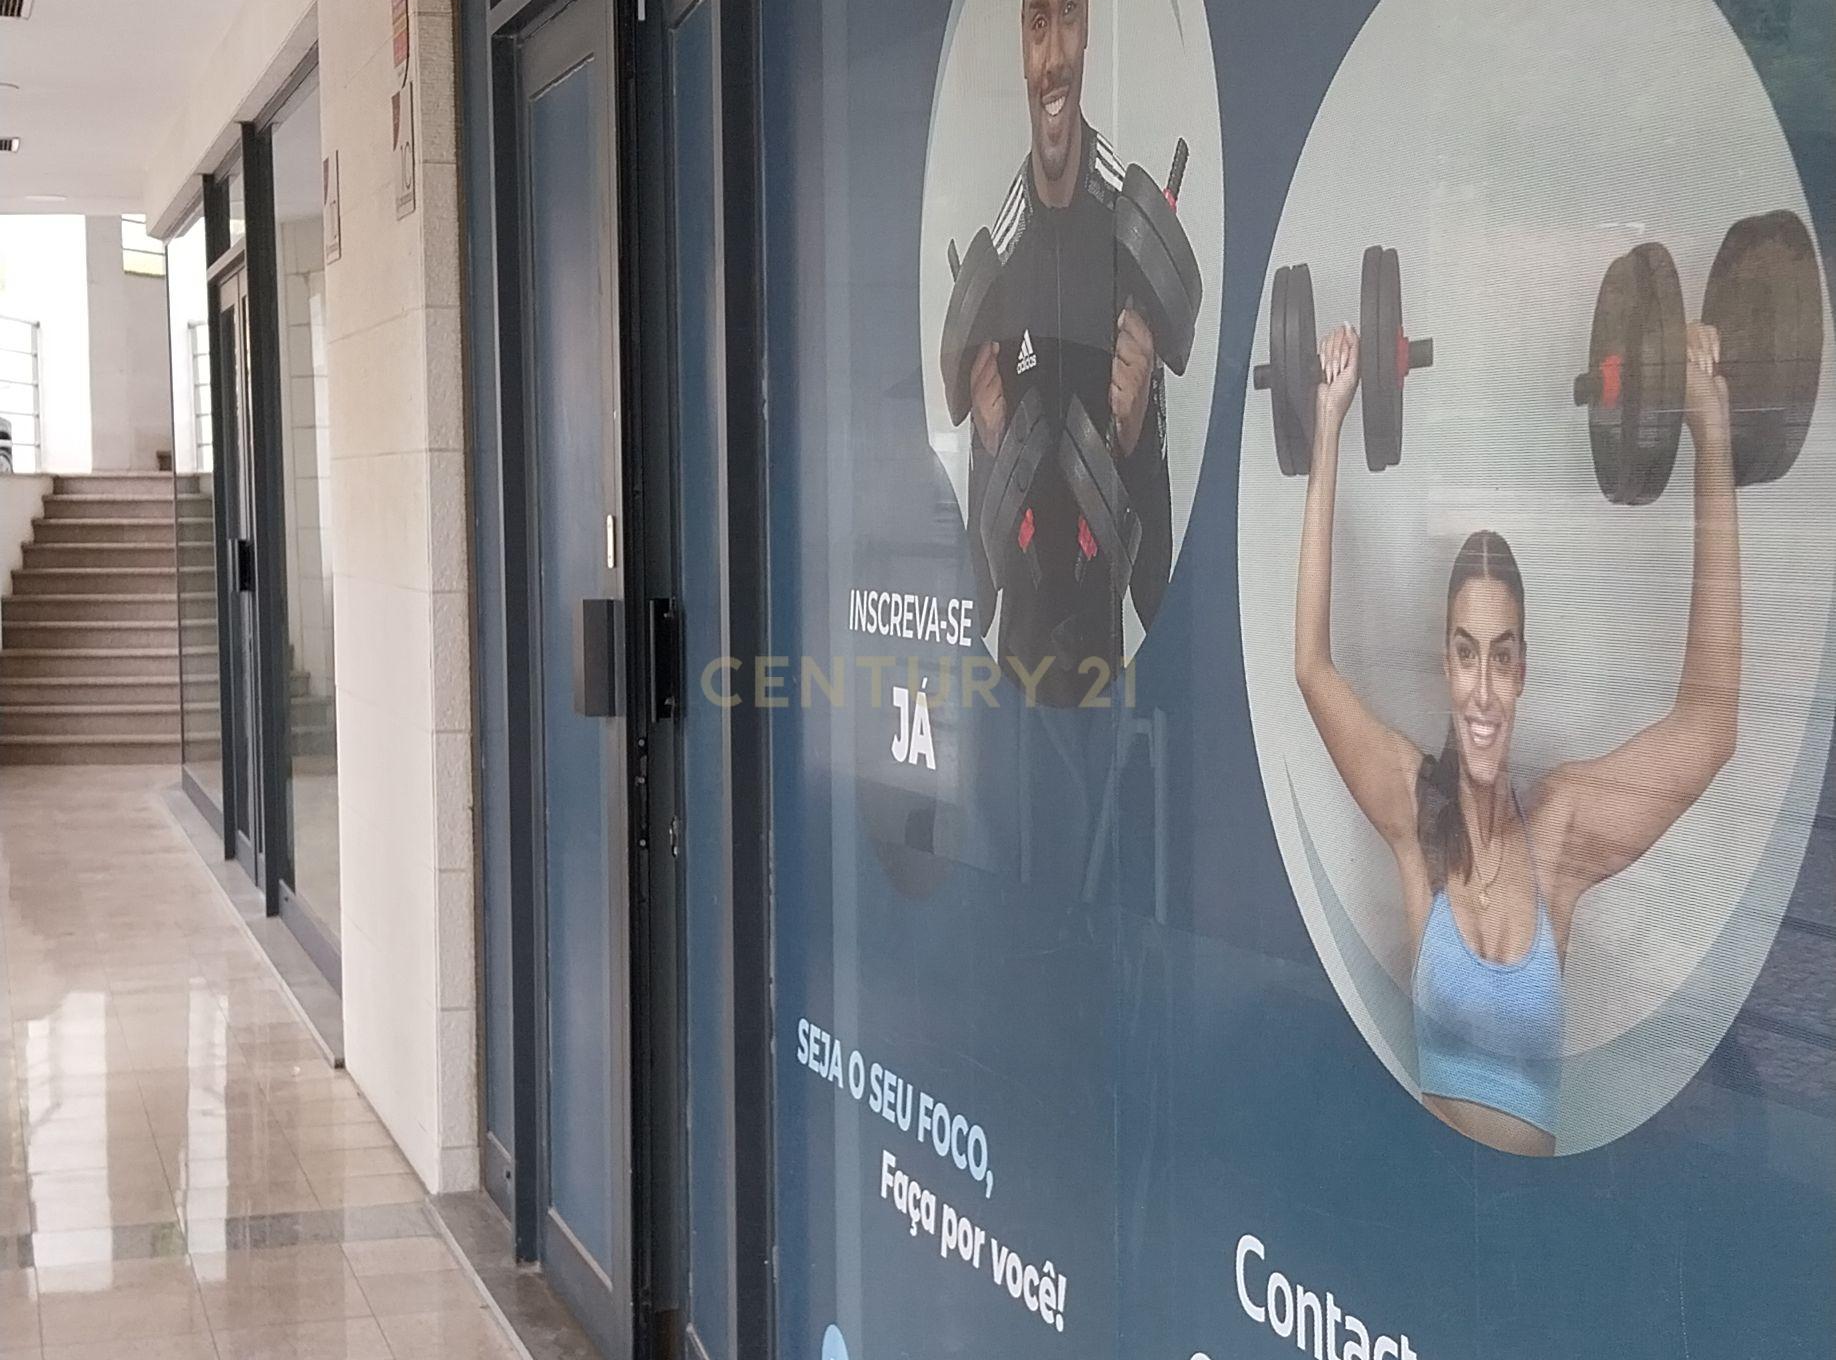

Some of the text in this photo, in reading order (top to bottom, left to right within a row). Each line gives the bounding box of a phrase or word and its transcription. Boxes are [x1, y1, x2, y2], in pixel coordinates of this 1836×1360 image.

[1016, 354, 1037, 375] adidas
[849, 589, 973, 647] INSCREVA-SE
[891, 677, 936, 770] JÁ
[797, 1018, 994, 1199] SEJA O SEU FOCO,
[881, 1149, 1067, 1332] Faça por você!
